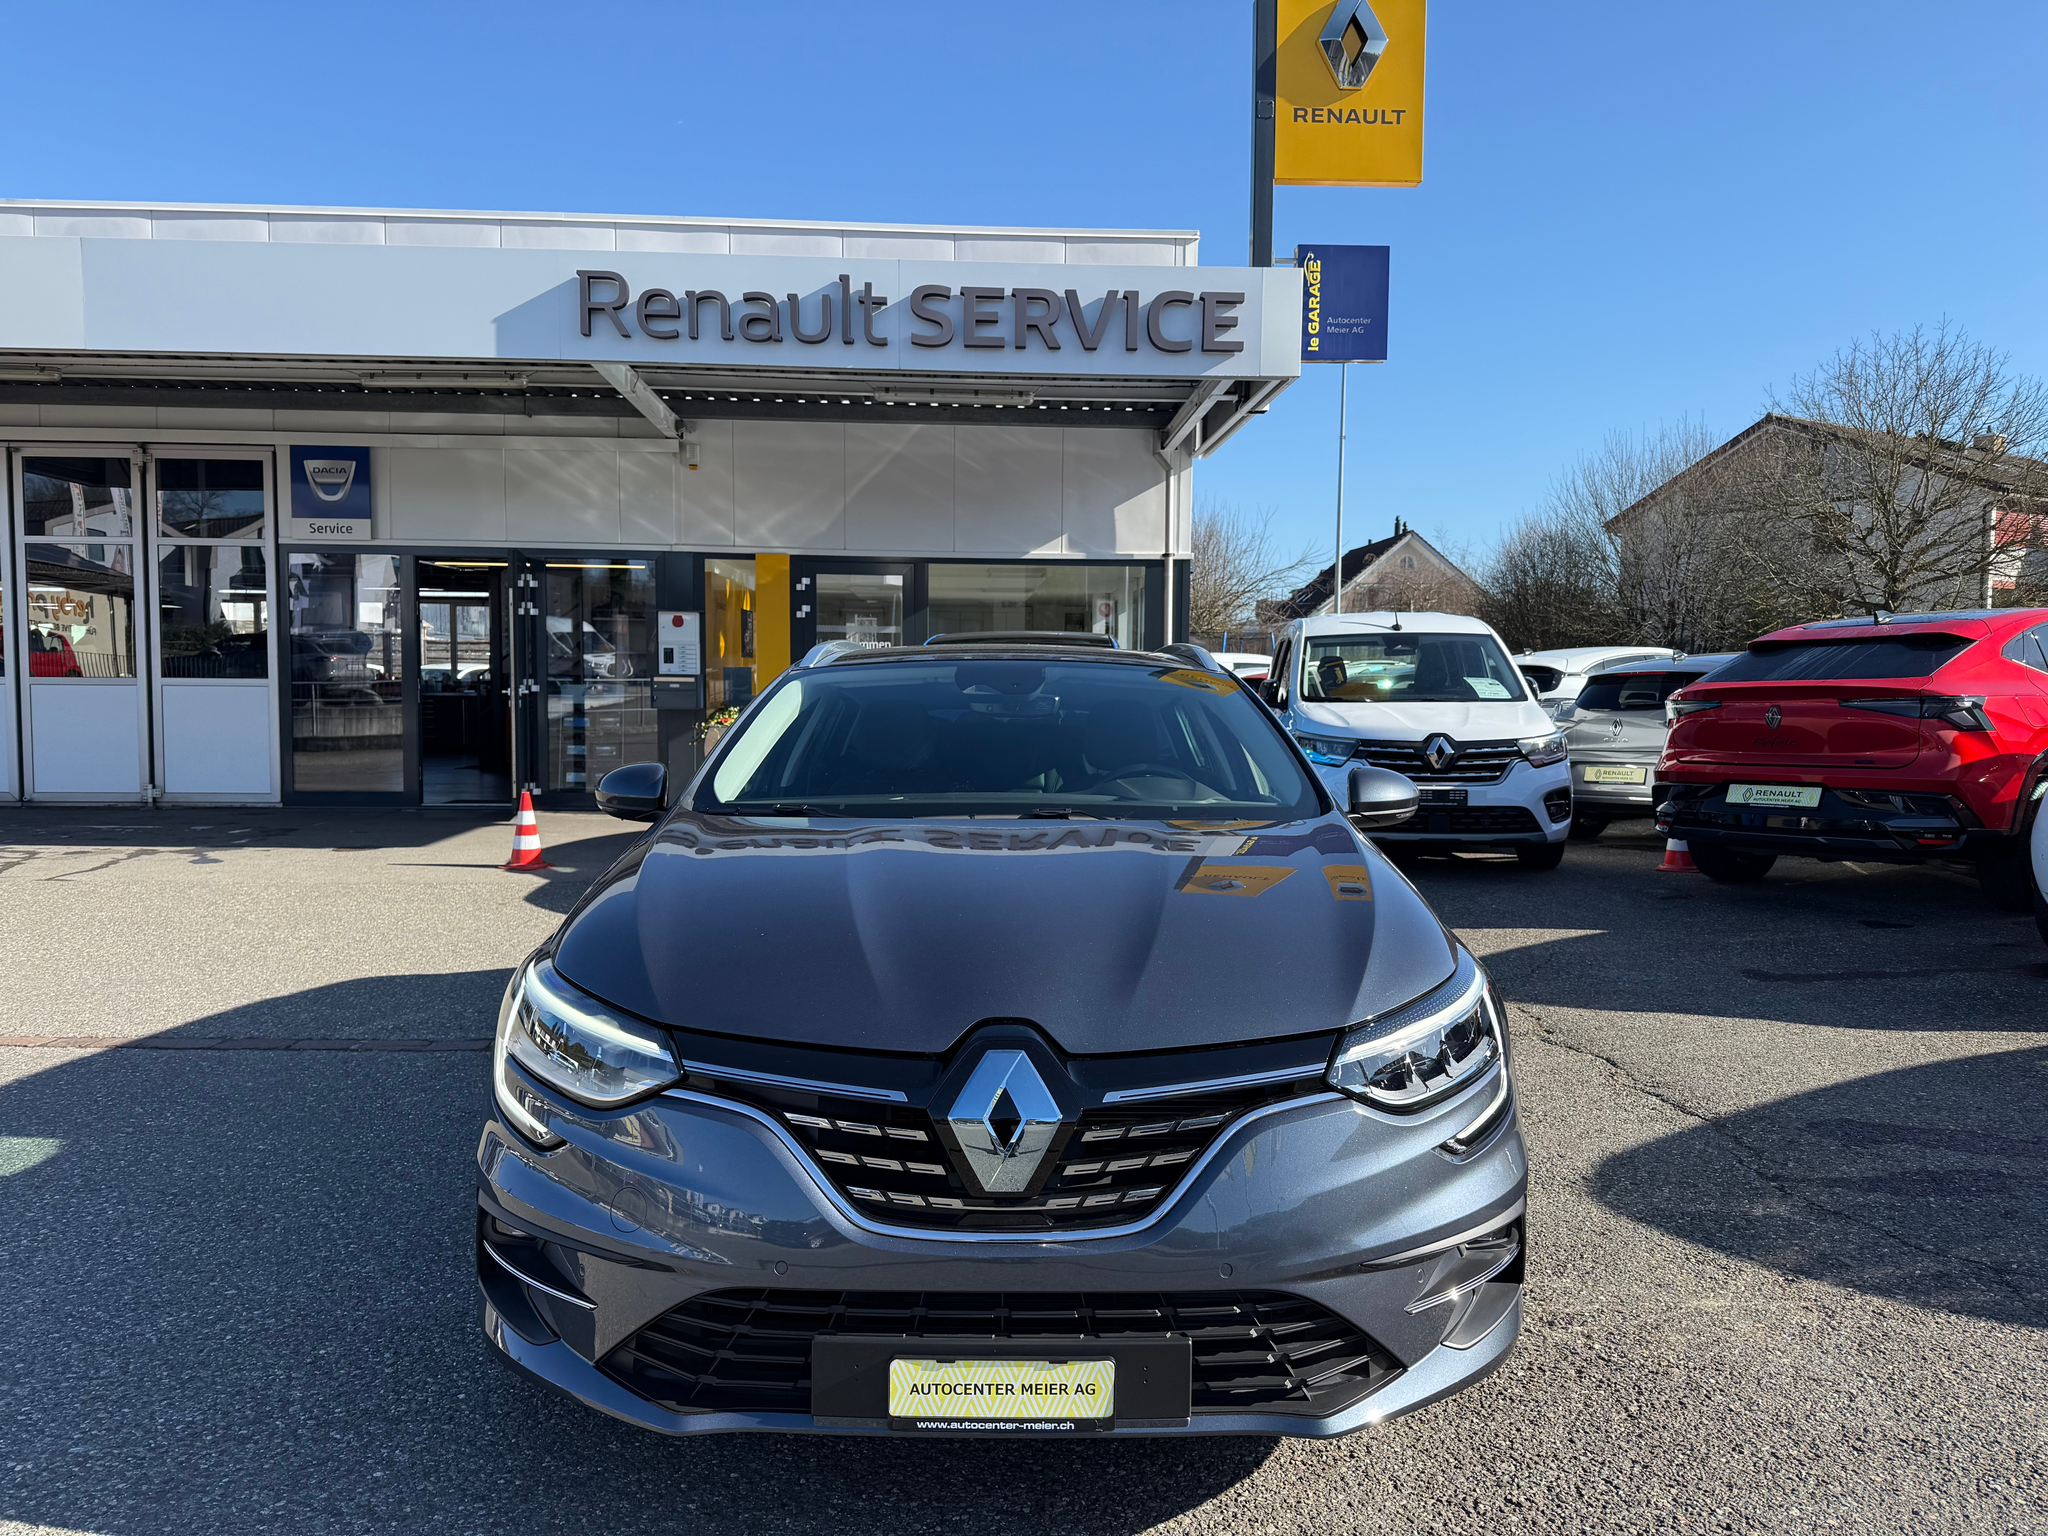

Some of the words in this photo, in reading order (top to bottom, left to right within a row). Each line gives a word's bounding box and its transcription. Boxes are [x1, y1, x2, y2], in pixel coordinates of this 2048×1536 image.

[1293, 107, 1406, 125] RENAULT
[1308, 259, 1321, 335] GARAGE
[576, 270, 889, 348] Renault
[910, 283, 1245, 354] SERVICE
[1326, 316, 1372, 325] Autocenter
[1326, 326, 1350, 334] Meier
[1351, 326, 1365, 334] AG
[1307, 337, 1319, 352] le
[312, 466, 347, 474] DACIA
[309, 522, 353, 534] Service
[1755, 789, 1804, 798] RENAULT
[909, 1383, 1015, 1396] AUTOCENTER
[1021, 1383, 1069, 1396] MEIER
[1074, 1383, 1097, 1396] AG
[916, 1420, 1075, 1431] www.autocenter-meier.ch
